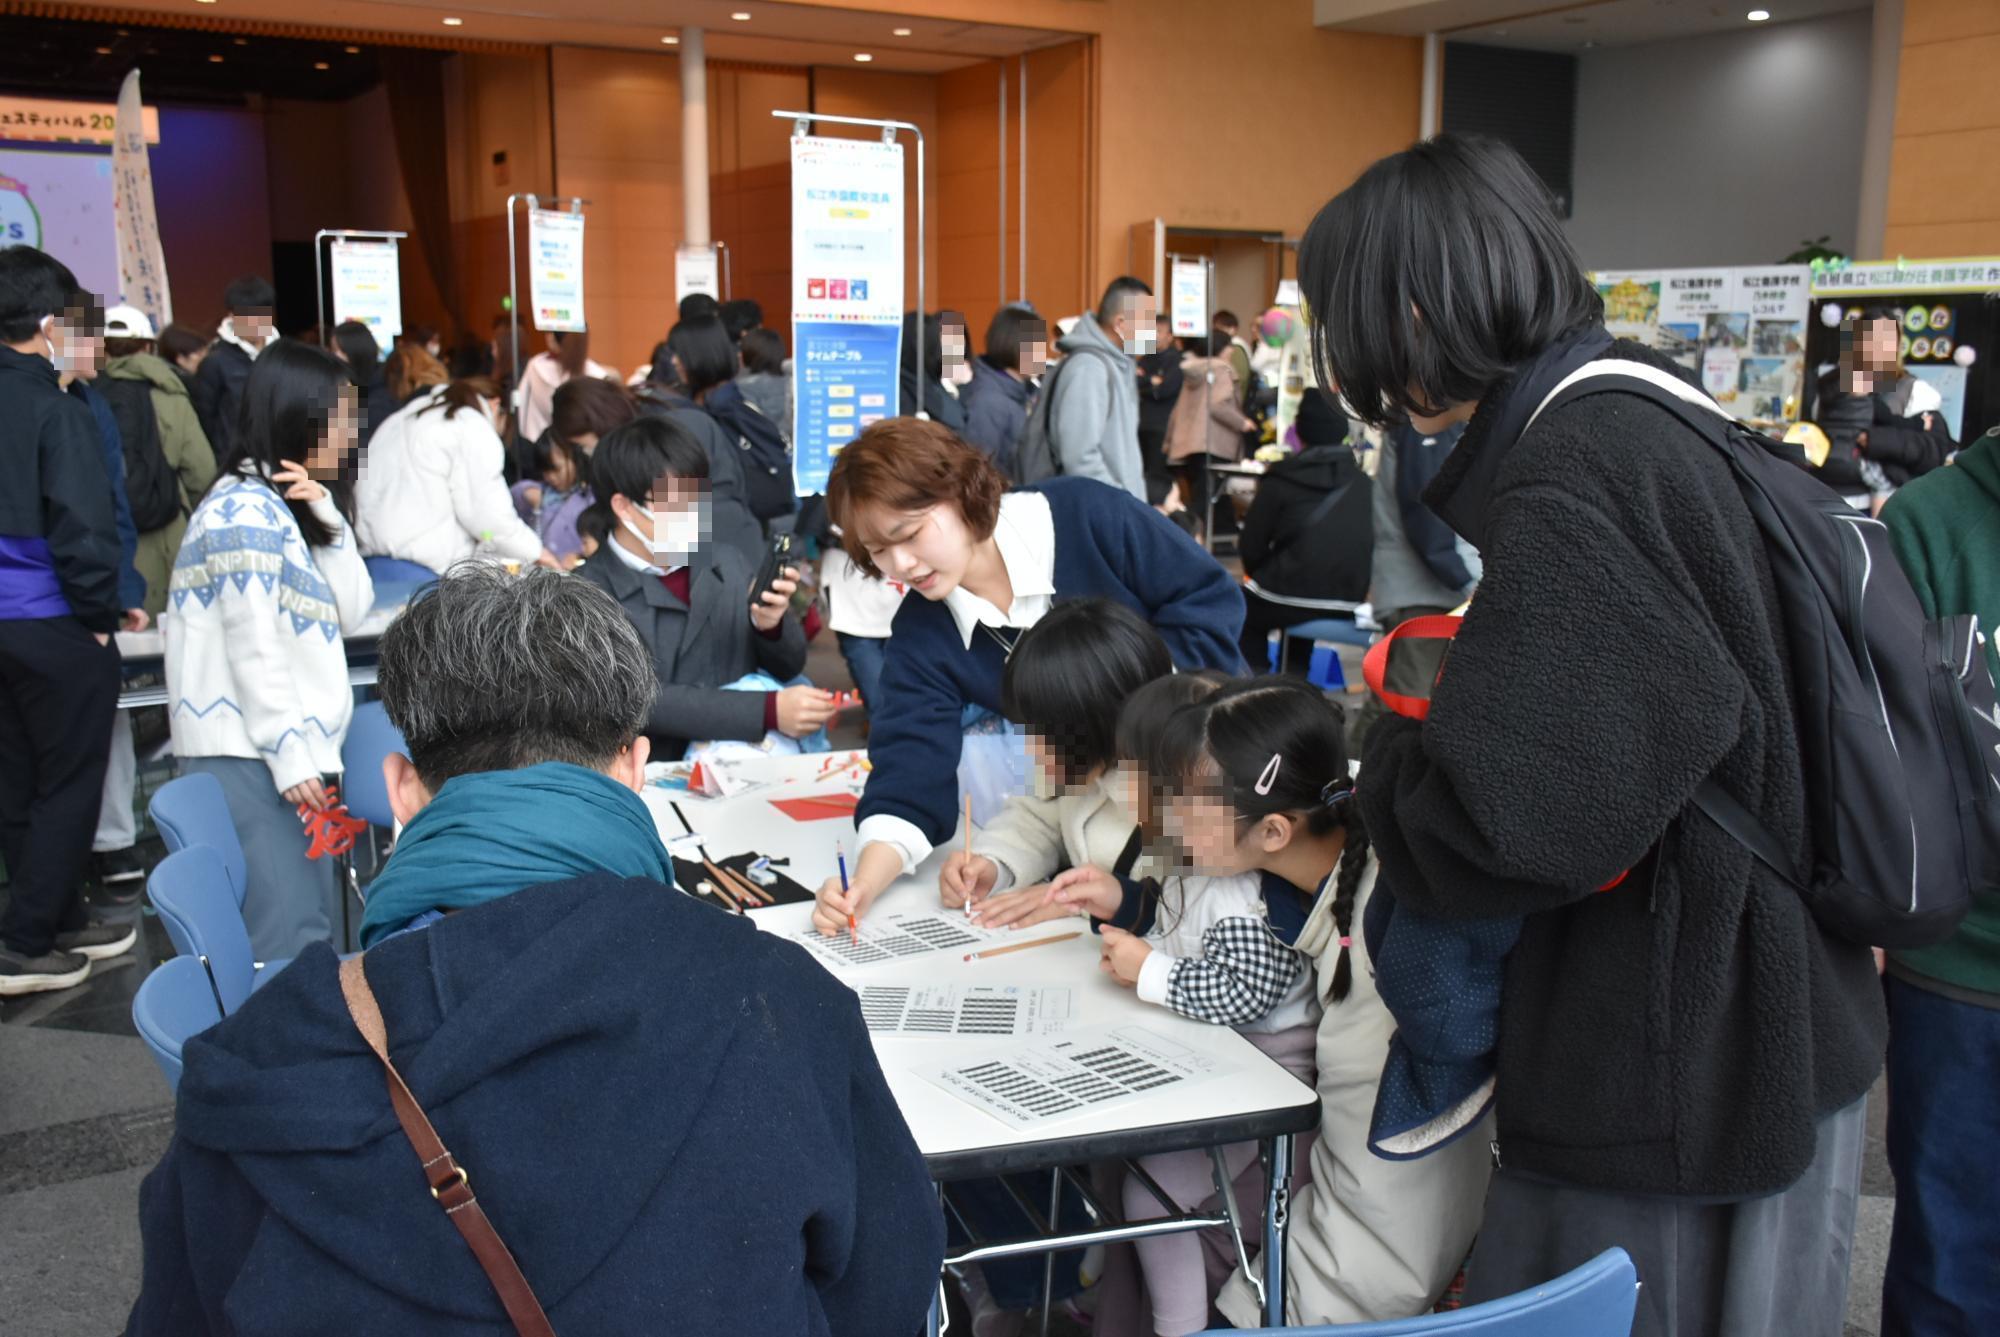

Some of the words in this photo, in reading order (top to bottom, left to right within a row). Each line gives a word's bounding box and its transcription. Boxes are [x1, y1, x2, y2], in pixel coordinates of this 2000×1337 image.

[806, 351, 862, 361] タイムテーブル
